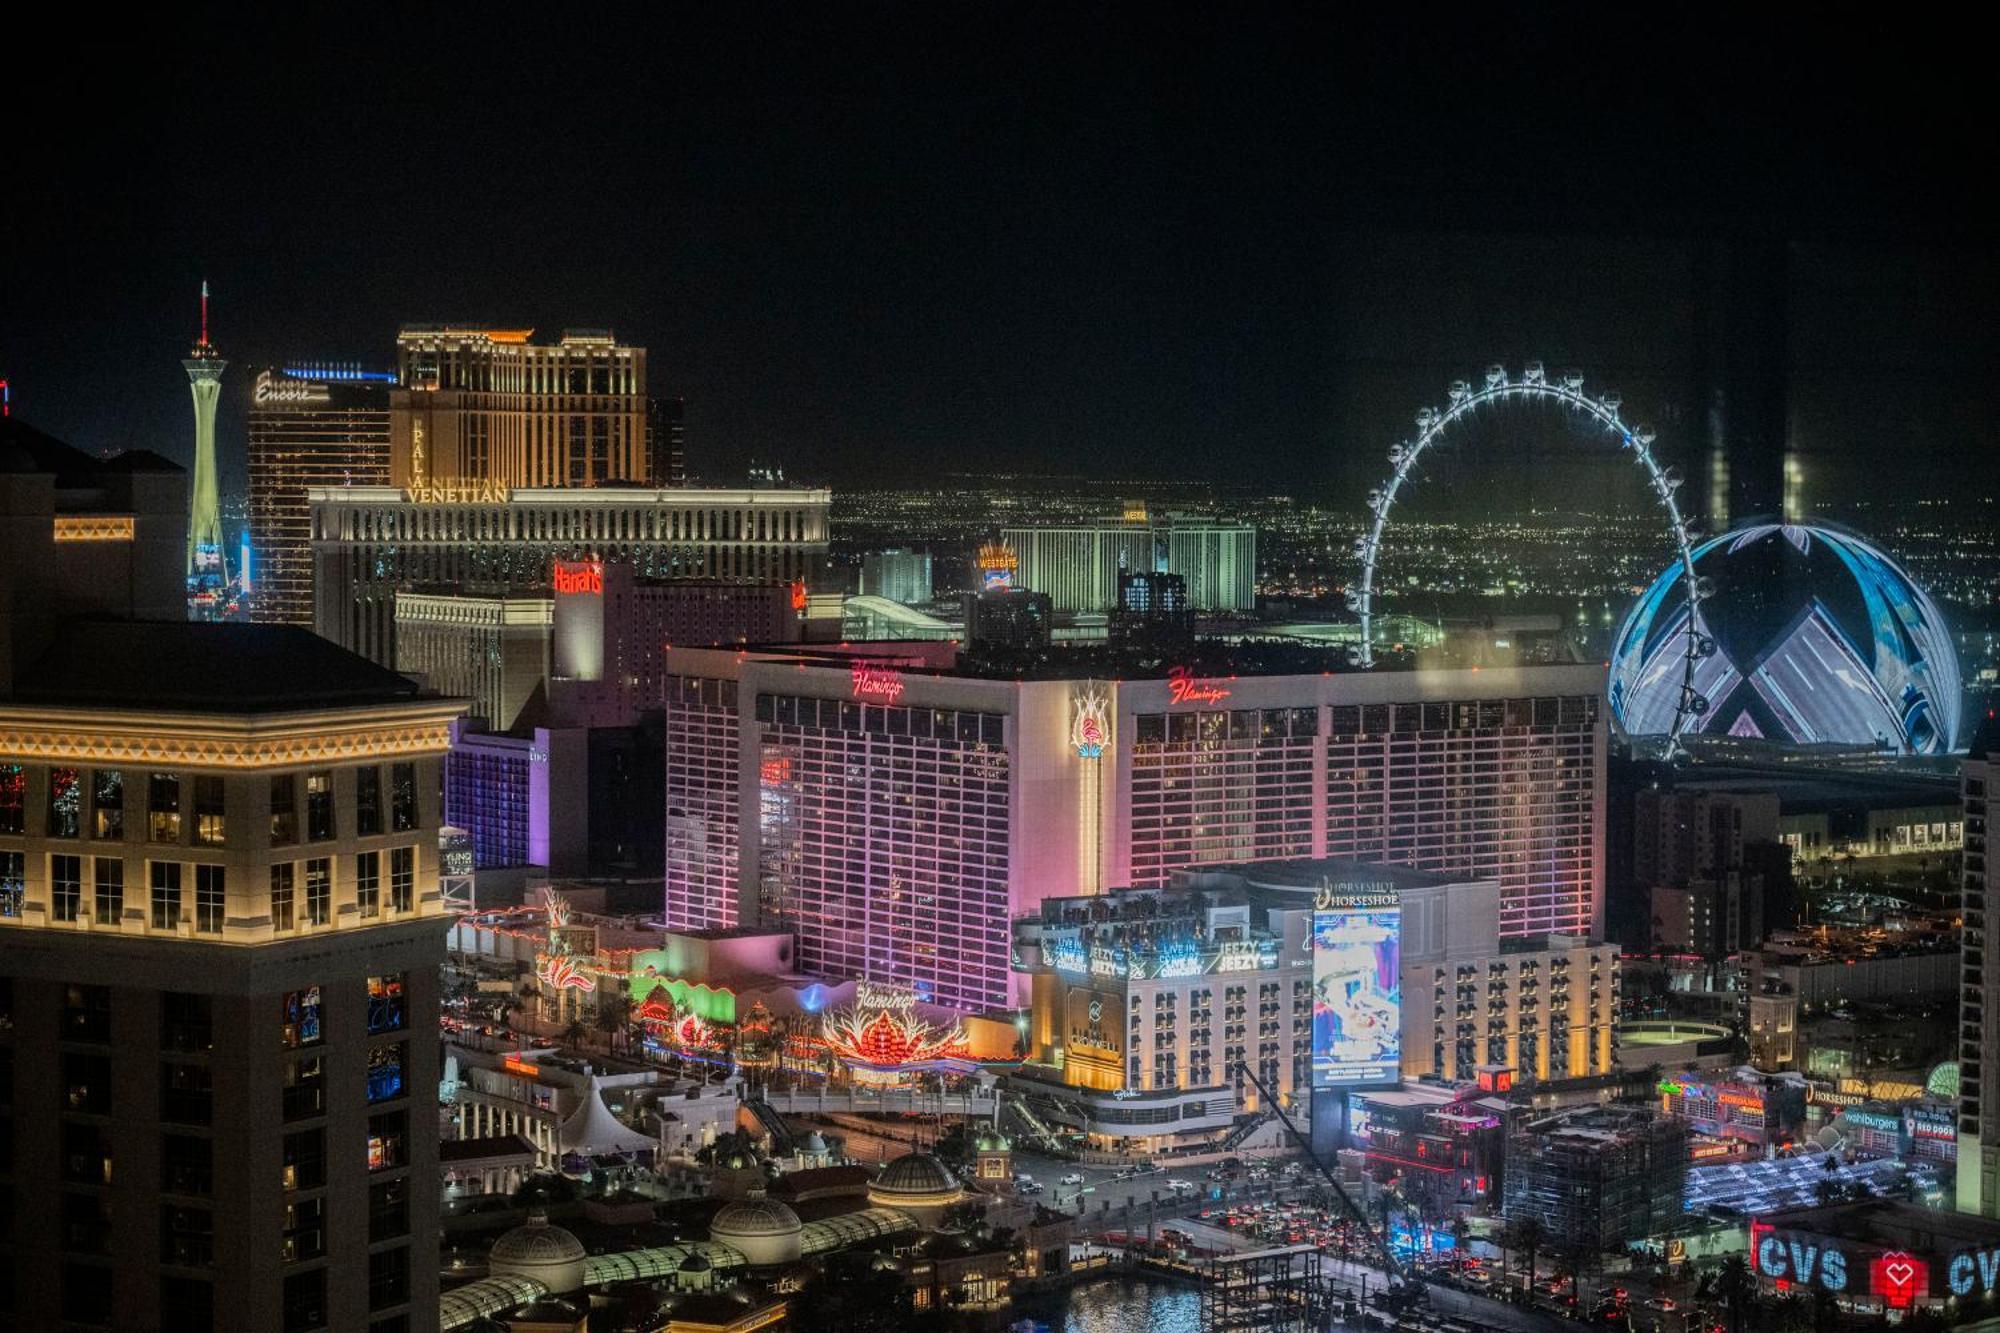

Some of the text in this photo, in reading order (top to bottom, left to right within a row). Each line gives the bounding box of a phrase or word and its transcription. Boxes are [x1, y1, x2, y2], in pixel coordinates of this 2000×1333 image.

[256, 383, 330, 401] Encore
[407, 488, 508, 504] VENETIAN
[853, 671, 904, 701] Flamingo
[1168, 679, 1232, 705] Flamingo
[1331, 895, 1400, 907] HORSESHOE
[1161, 965, 1201, 977] CONCERT
[1218, 954, 1260, 972] JEEZY
[856, 986, 917, 1011] Flamingo
[1845, 1112, 1898, 1130] wahlburgers
[1759, 1237, 1847, 1291] CVS
